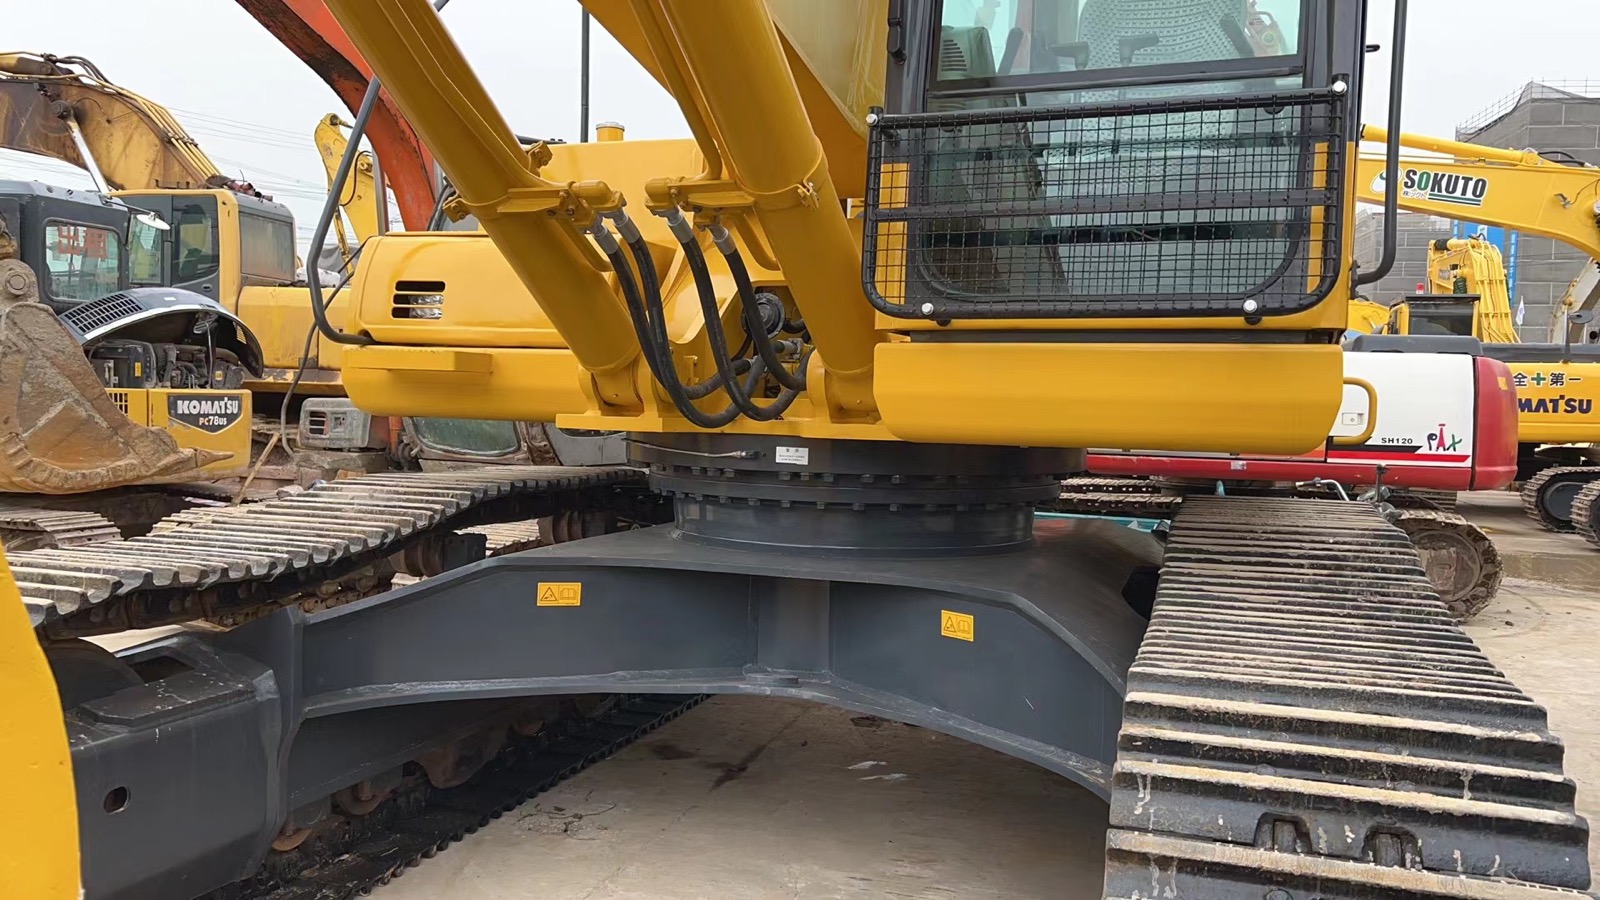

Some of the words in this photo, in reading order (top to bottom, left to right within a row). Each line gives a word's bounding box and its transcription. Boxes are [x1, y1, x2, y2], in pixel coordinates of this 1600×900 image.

[1403, 169, 1488, 198] SOKUTO
[177, 396, 239, 414] KOMATSU
[198, 416, 227, 425] PC78US
